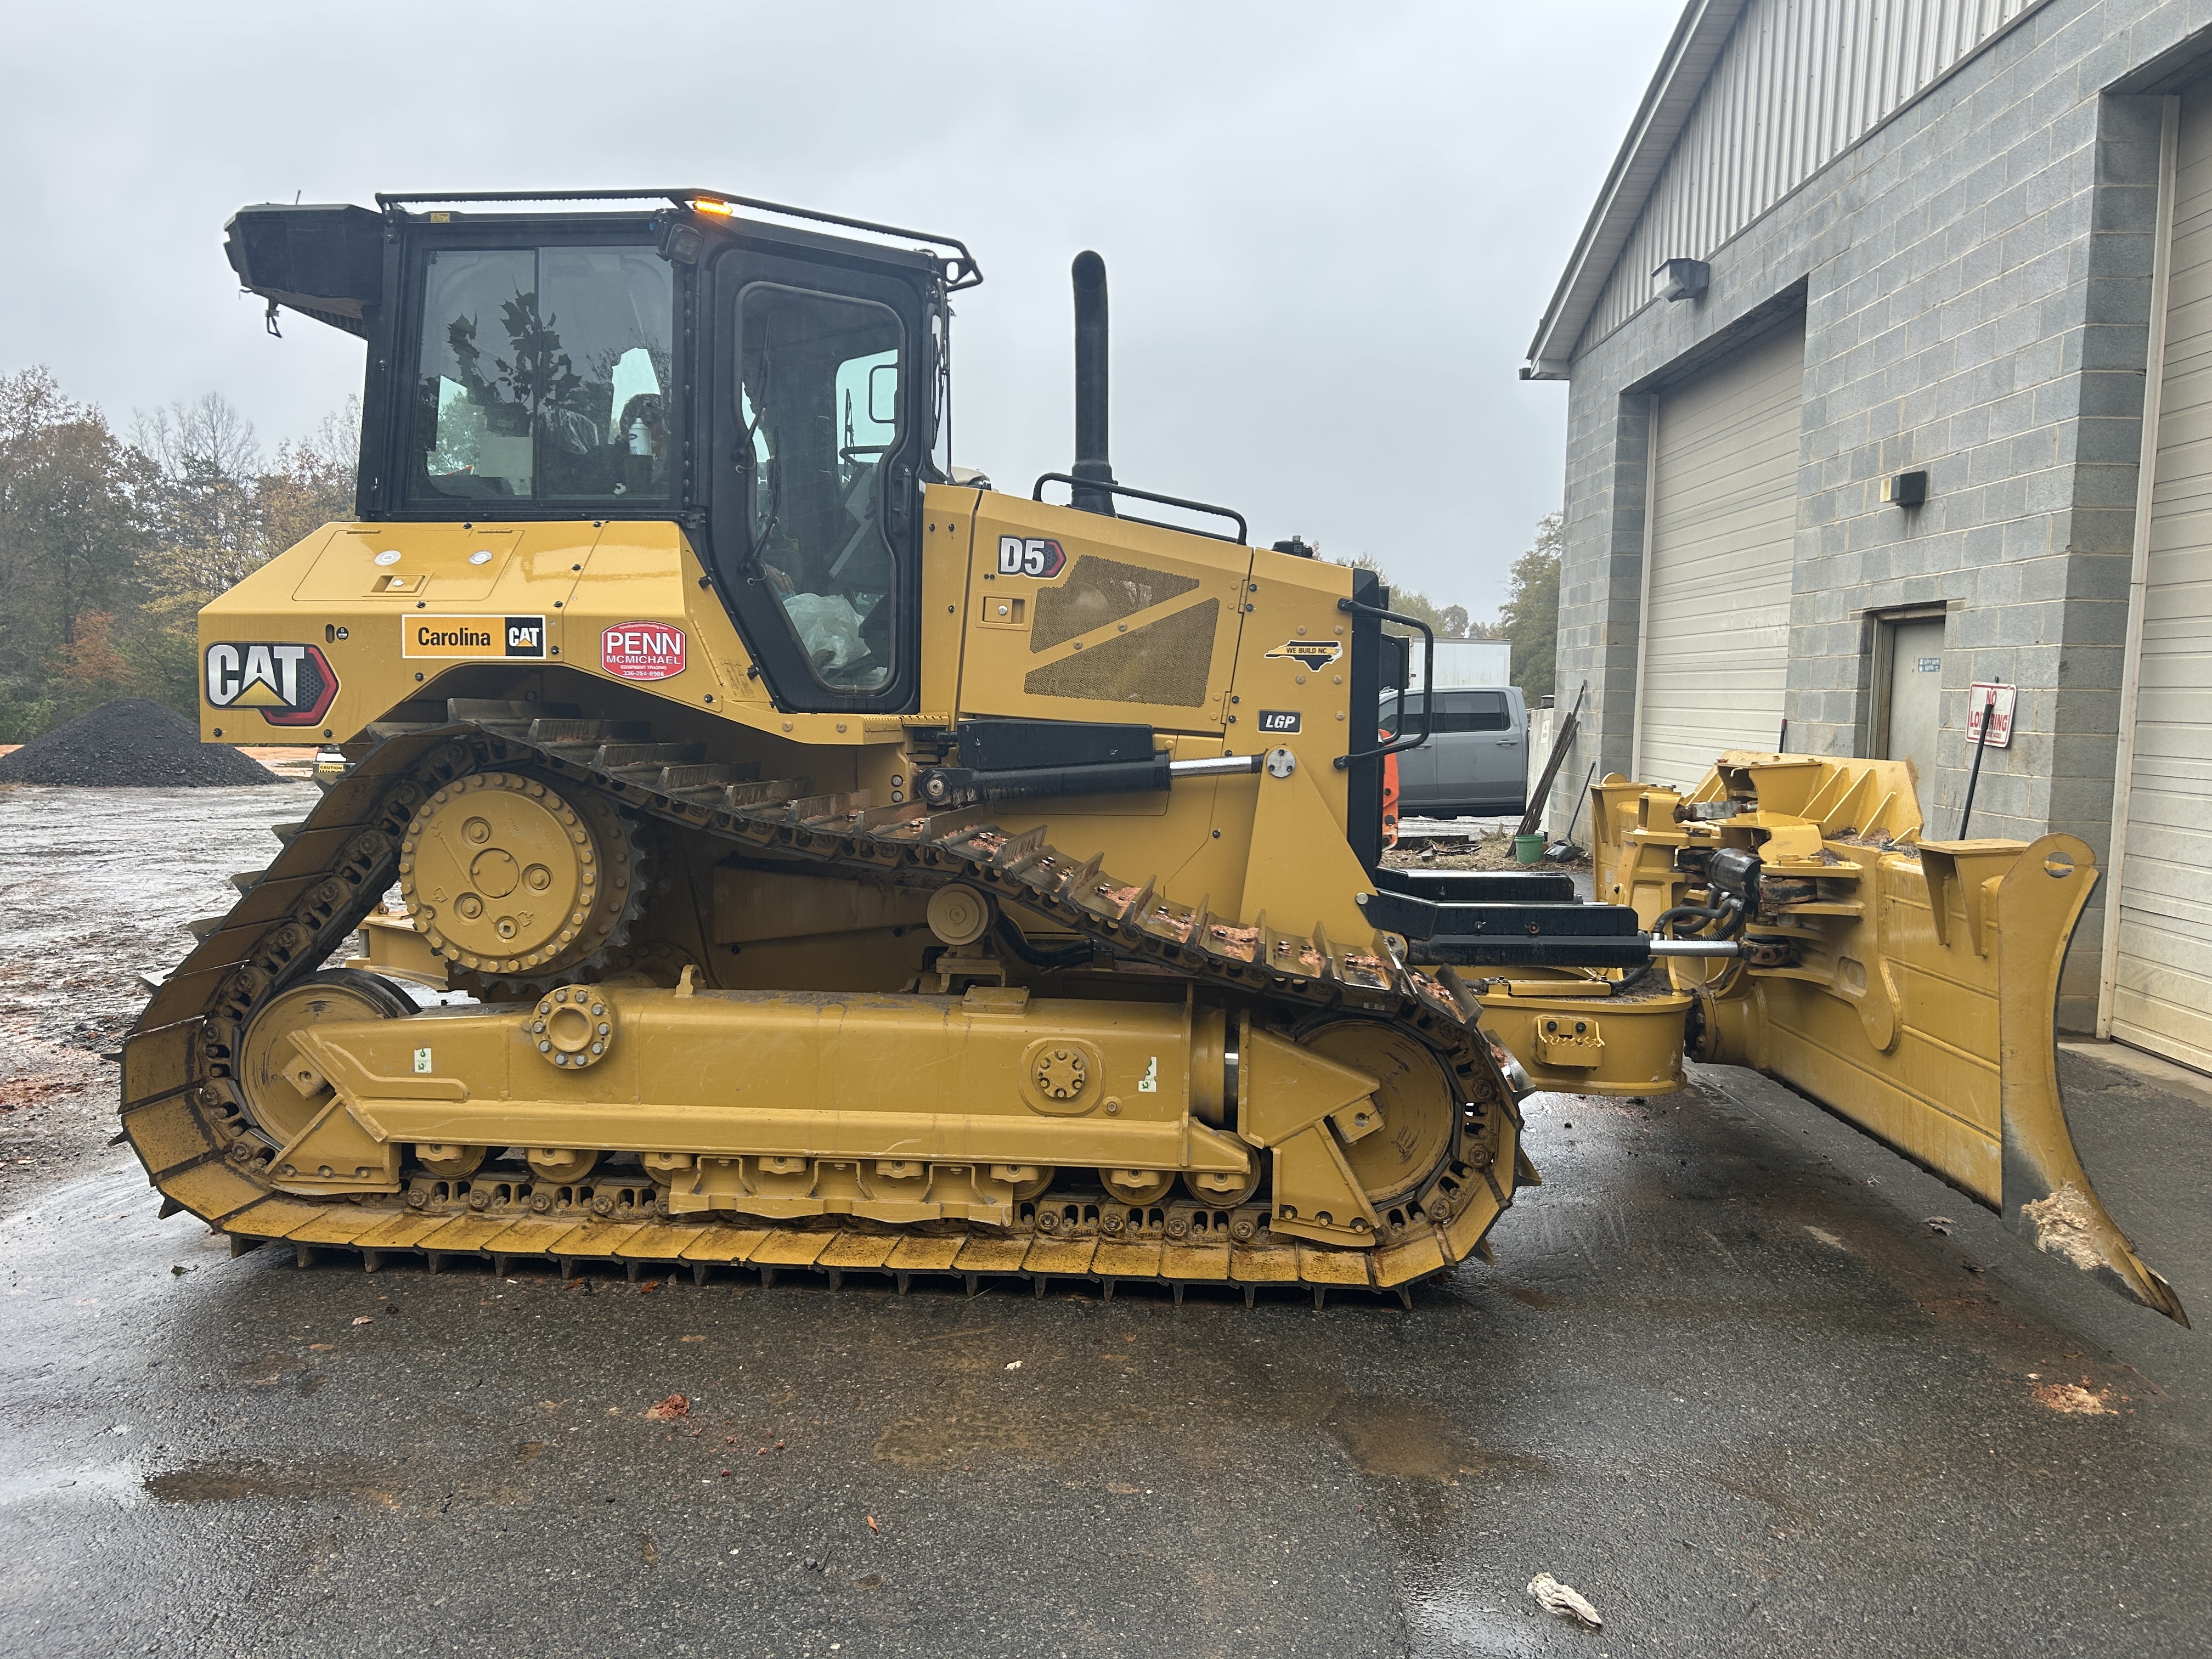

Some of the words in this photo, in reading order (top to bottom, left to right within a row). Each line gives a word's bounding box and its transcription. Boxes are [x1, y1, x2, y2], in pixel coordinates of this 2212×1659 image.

[1000, 537, 1045, 575] D5
[417, 627, 491, 646] Carolina
[508, 627, 540, 648] CAT
[607, 631, 681, 655] PENN
[606, 655, 681, 664] MCMICHAEL
[207, 644, 305, 707] CAT
[1985, 690, 1997, 708] NO
[1265, 715, 1296, 729] LGP
[1970, 710, 2008, 732] LOIRING
